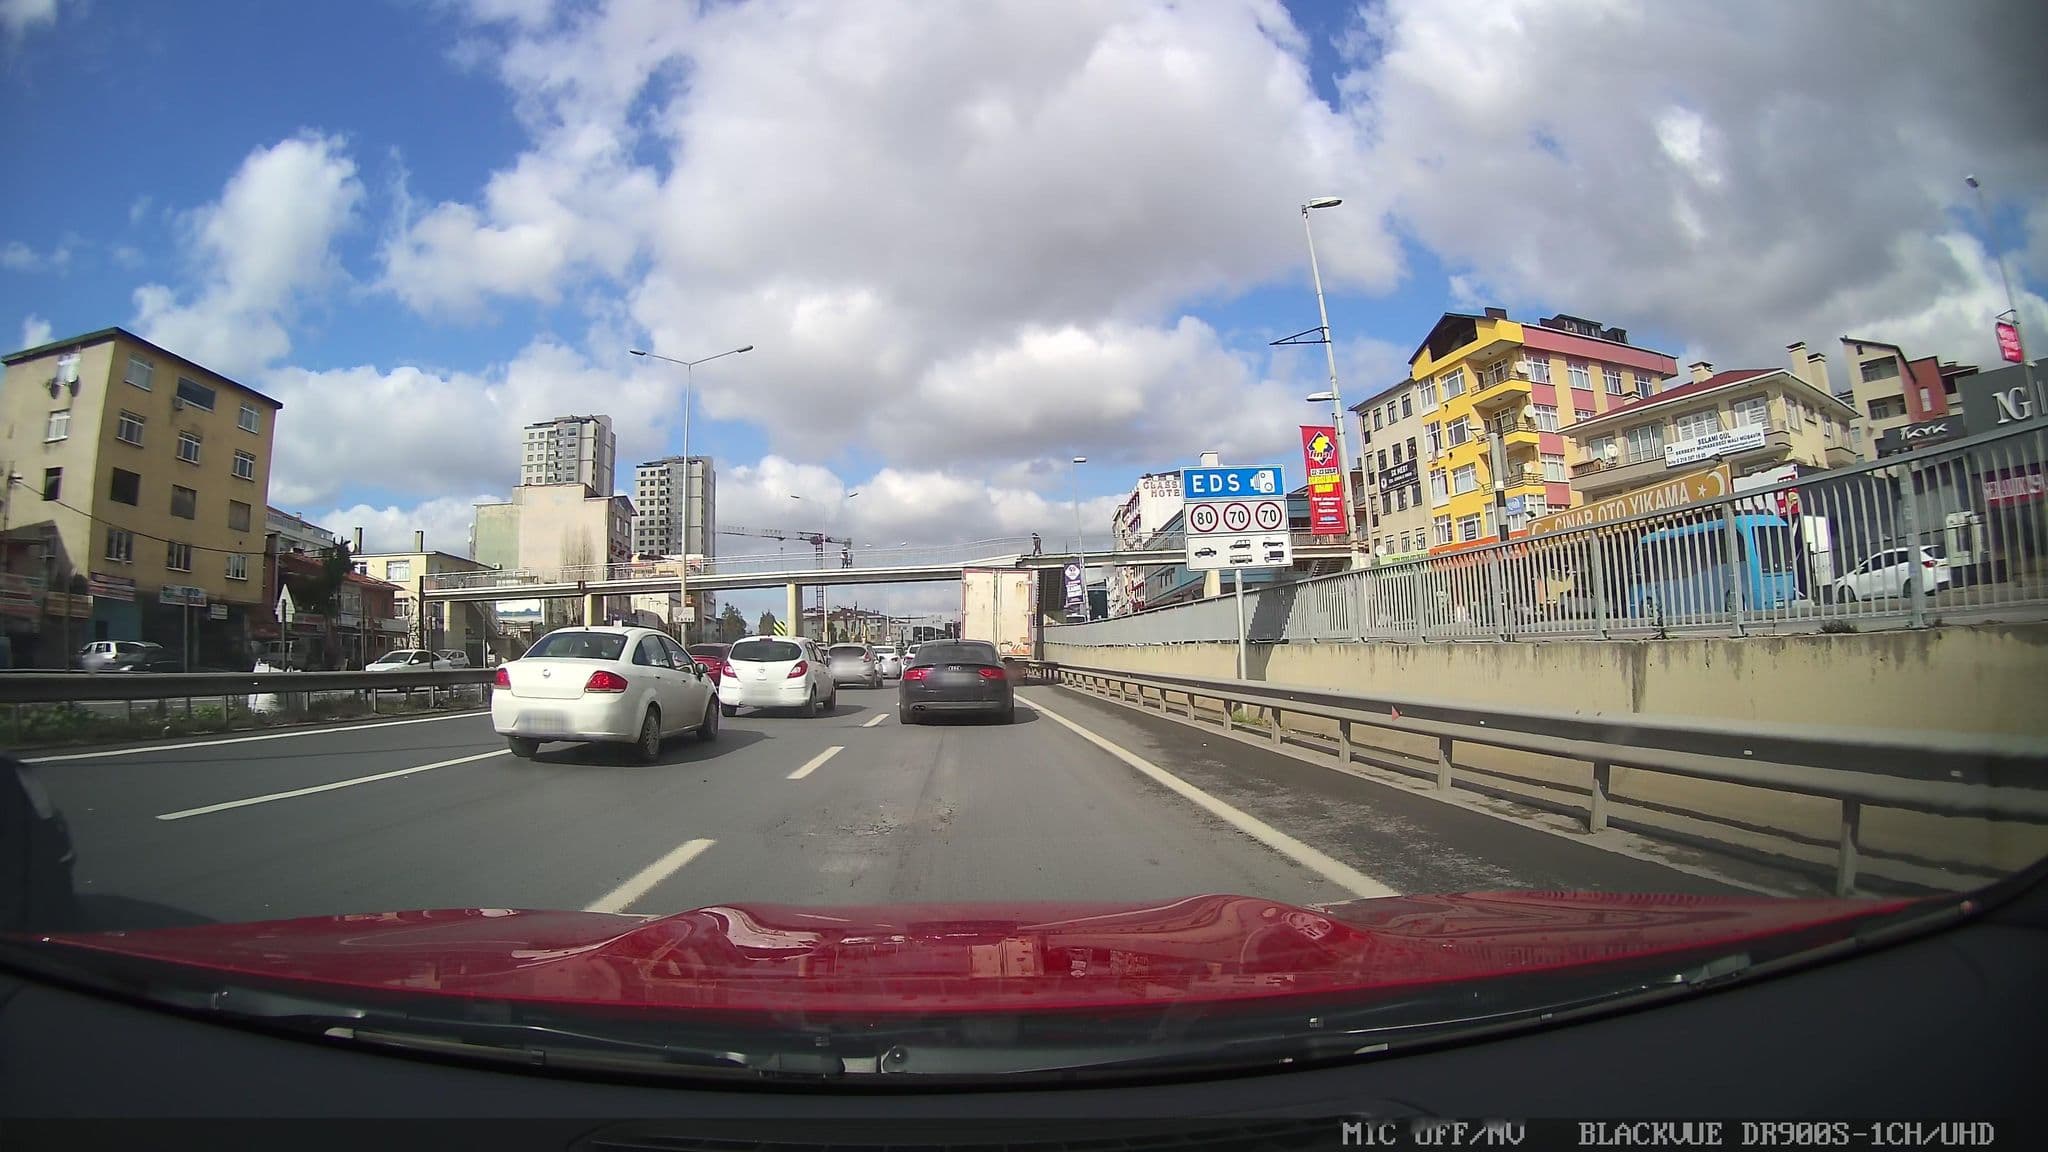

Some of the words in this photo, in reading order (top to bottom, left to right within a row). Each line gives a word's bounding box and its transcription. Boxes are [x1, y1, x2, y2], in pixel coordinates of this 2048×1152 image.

[1192, 474, 1241, 493] EDS
[1598, 500, 1627, 521] OTO
[1629, 482, 1691, 515] YIKAMA
[1197, 511, 1213, 525] 80
[1229, 510, 1245, 524] 70
[1261, 509, 1277, 523] 70
